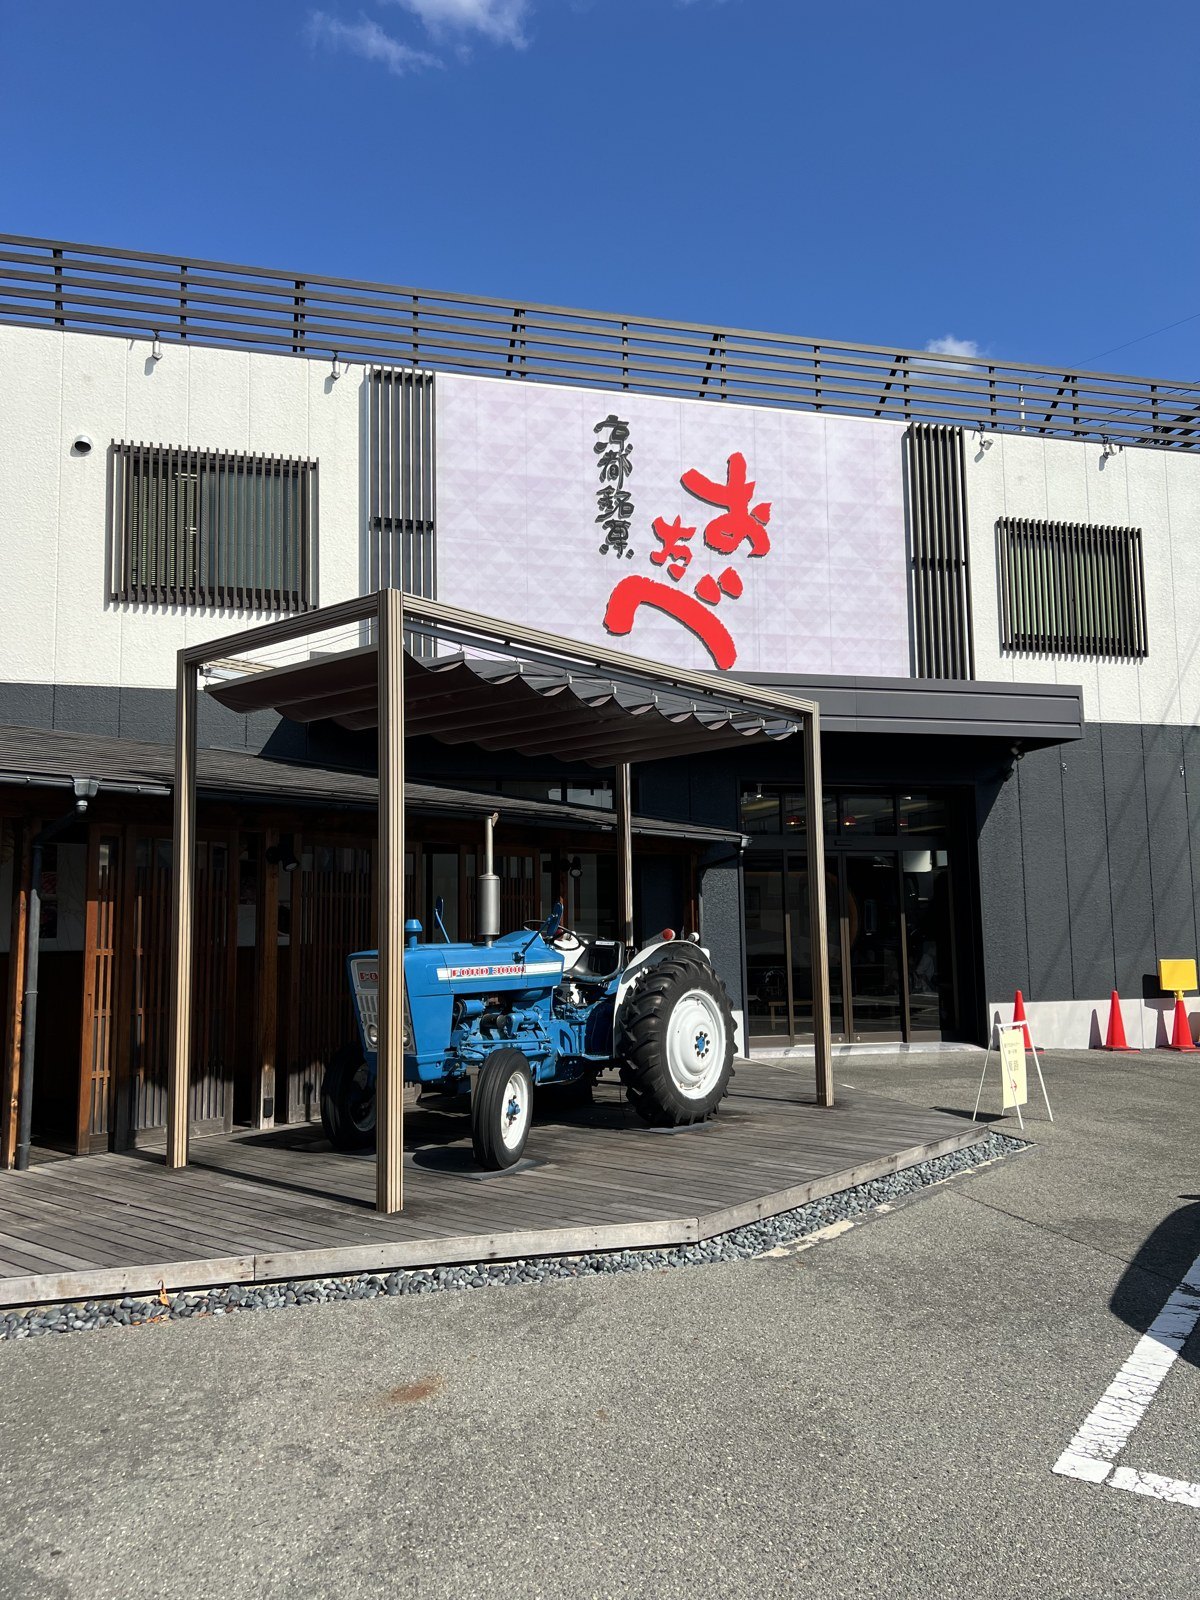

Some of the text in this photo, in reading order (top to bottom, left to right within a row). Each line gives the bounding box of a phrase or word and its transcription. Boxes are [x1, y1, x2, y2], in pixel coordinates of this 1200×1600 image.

[593, 414, 635, 560] 京都銘菓
[603, 451, 772, 671] おたべ
[359, 971, 379, 981] FO
[451, 965, 526, 978] FORD 3000
